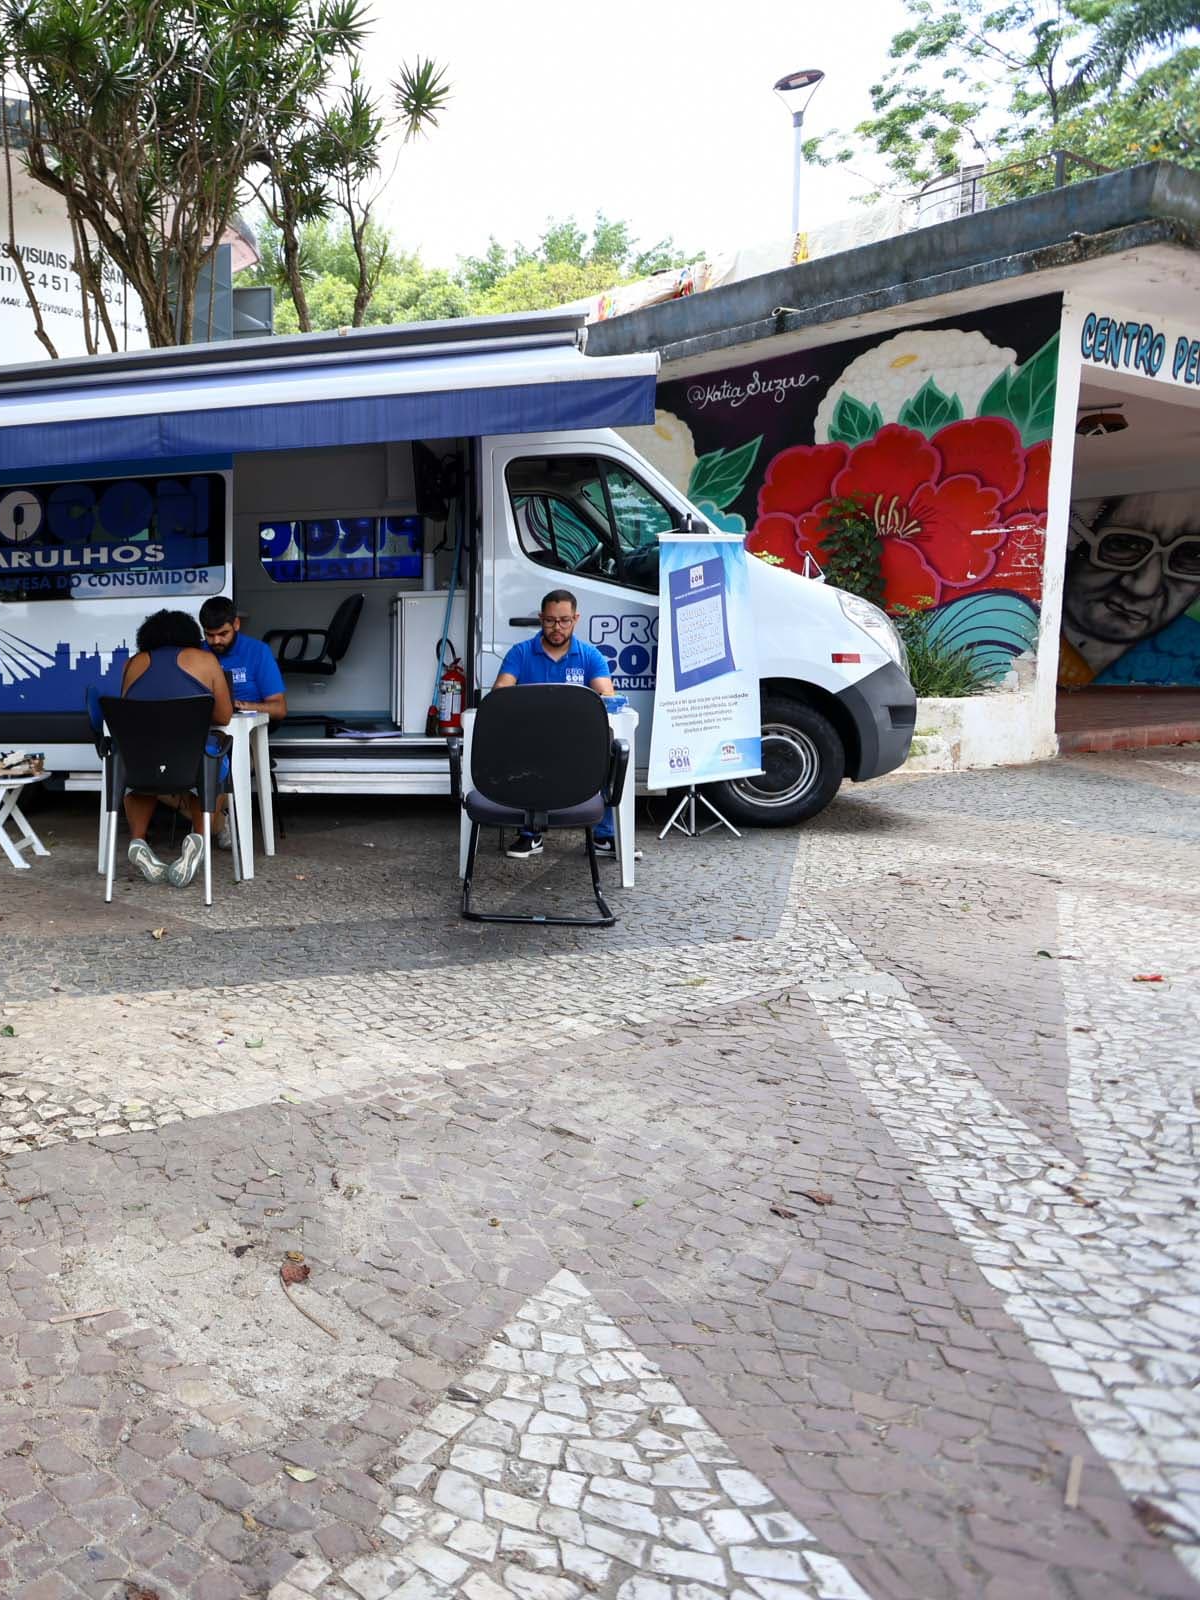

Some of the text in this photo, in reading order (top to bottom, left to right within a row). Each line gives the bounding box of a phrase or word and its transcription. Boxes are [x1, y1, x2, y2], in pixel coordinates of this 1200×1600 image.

[15, 245, 68, 270] VISUAIS
[1081, 312, 1200, 385] CENTRO PE
[88, 570, 209, 587] CONSUMIDOR
[589, 614, 659, 644] PR
[597, 645, 658, 675] CO
